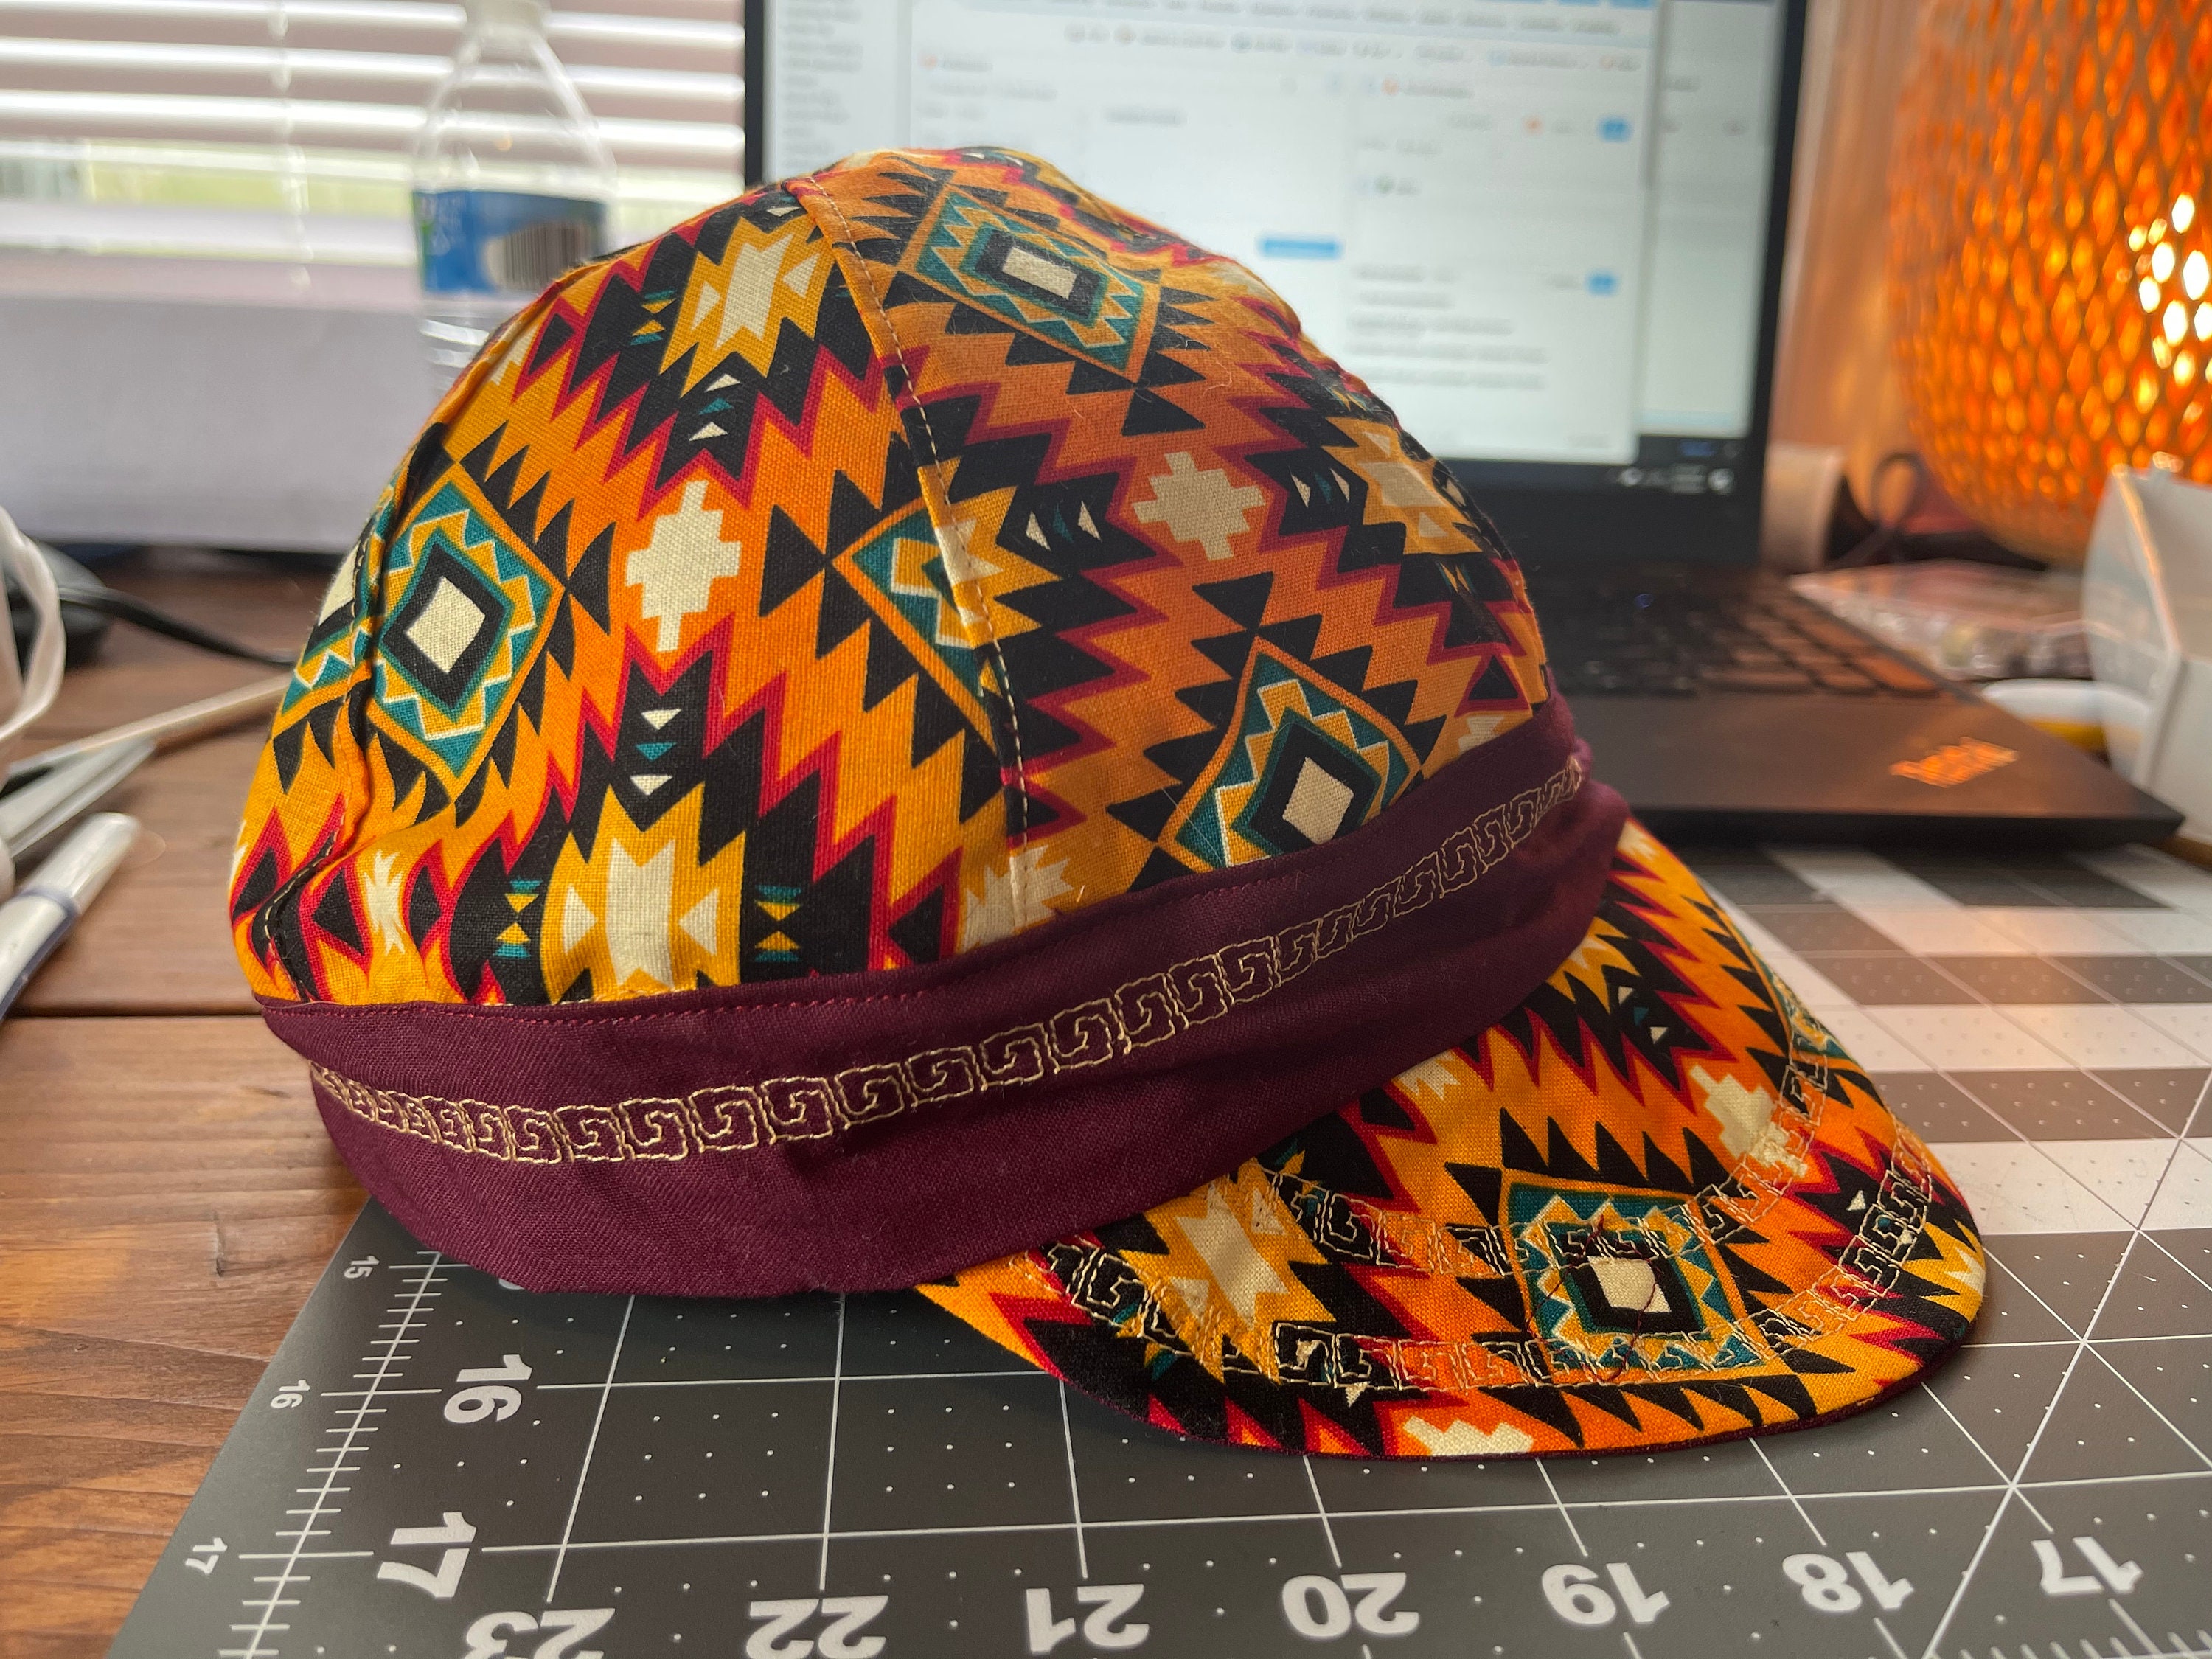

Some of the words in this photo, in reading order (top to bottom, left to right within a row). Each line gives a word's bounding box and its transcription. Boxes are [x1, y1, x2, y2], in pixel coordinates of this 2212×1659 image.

[343, 1255, 380, 1280] 15
[269, 1379, 311, 1410] 16
[442, 1353, 534, 1425] 16
[184, 1537, 229, 1576] 17
[375, 1510, 478, 1599] 17
[1781, 1551, 1916, 1613] 18
[2031, 1535, 2143, 1596] 17
[1025, 1583, 1150, 1655] 21
[1281, 1571, 1420, 1641] 20
[1540, 1562, 1671, 1627] 19
[461, 1607, 616, 1659] 23
[744, 1594, 889, 1659] 22
